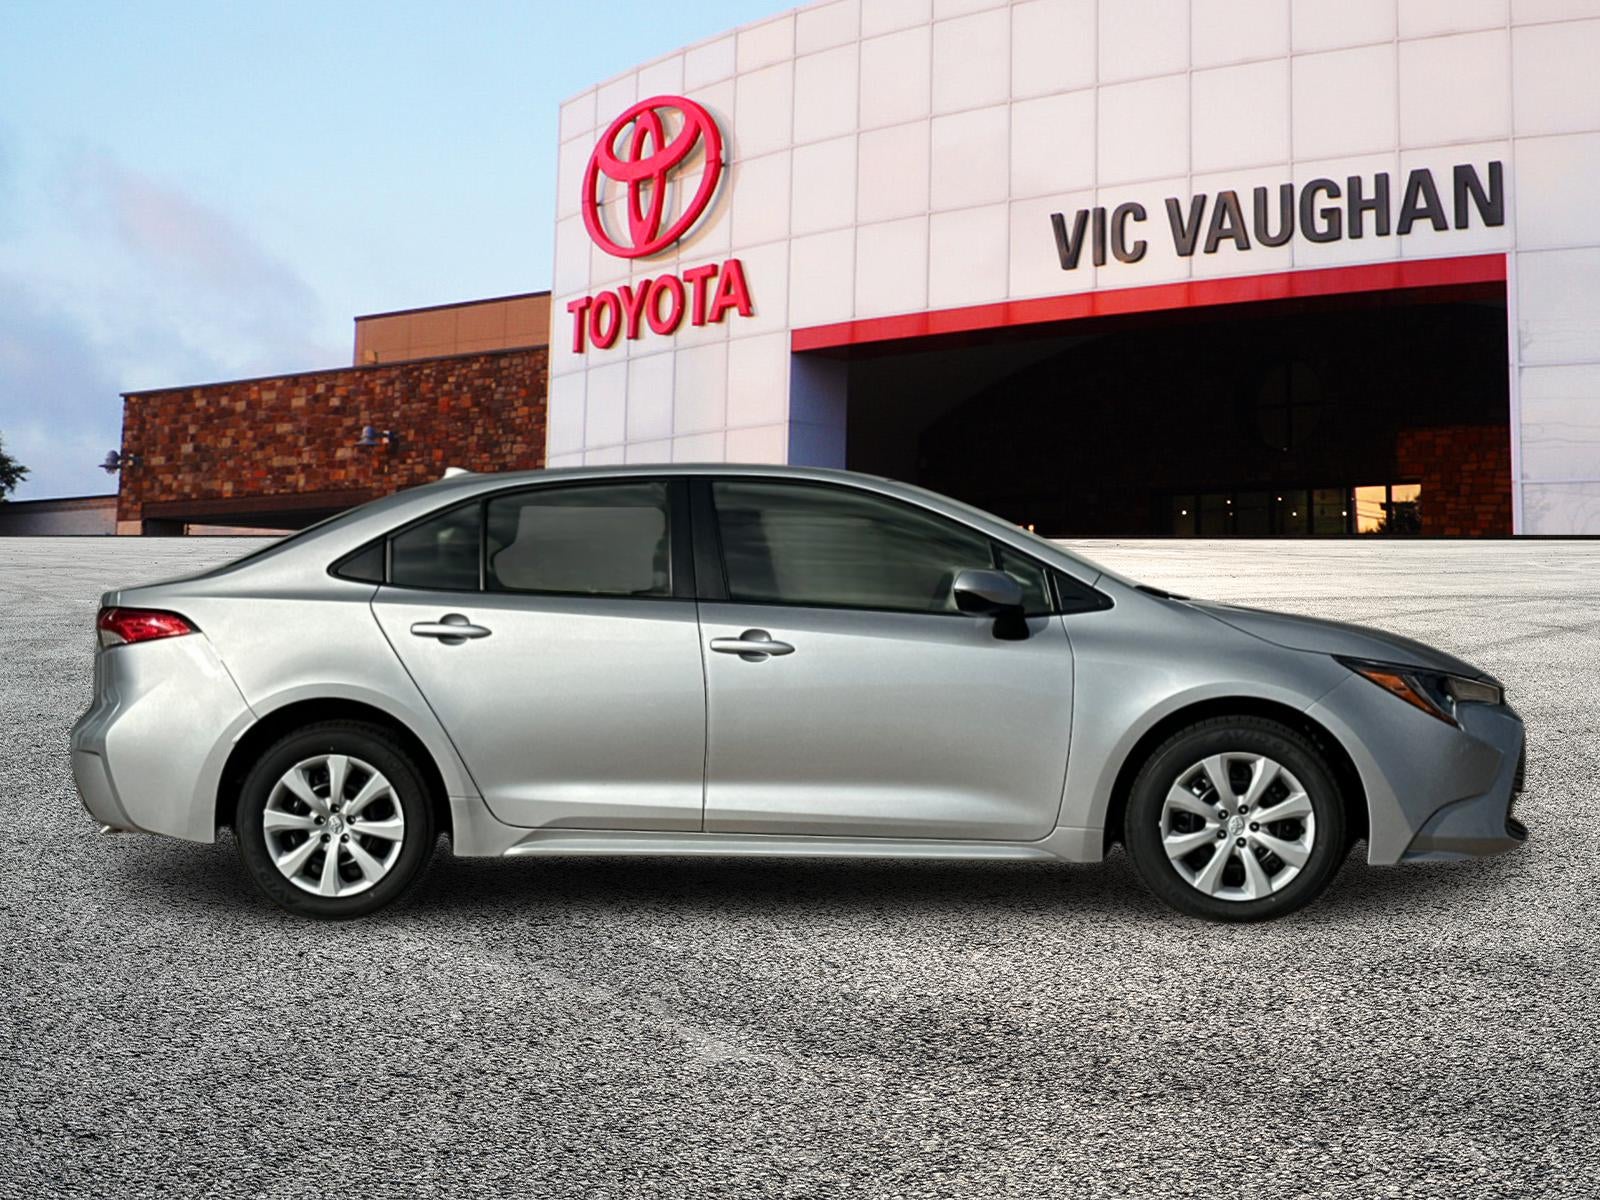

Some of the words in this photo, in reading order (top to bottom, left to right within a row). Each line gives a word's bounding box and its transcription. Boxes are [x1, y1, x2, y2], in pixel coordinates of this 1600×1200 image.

[1050, 201, 1147, 271] VIC
[1165, 160, 1505, 258] VAUGHAN
[567, 258, 754, 354] TOYOTA
